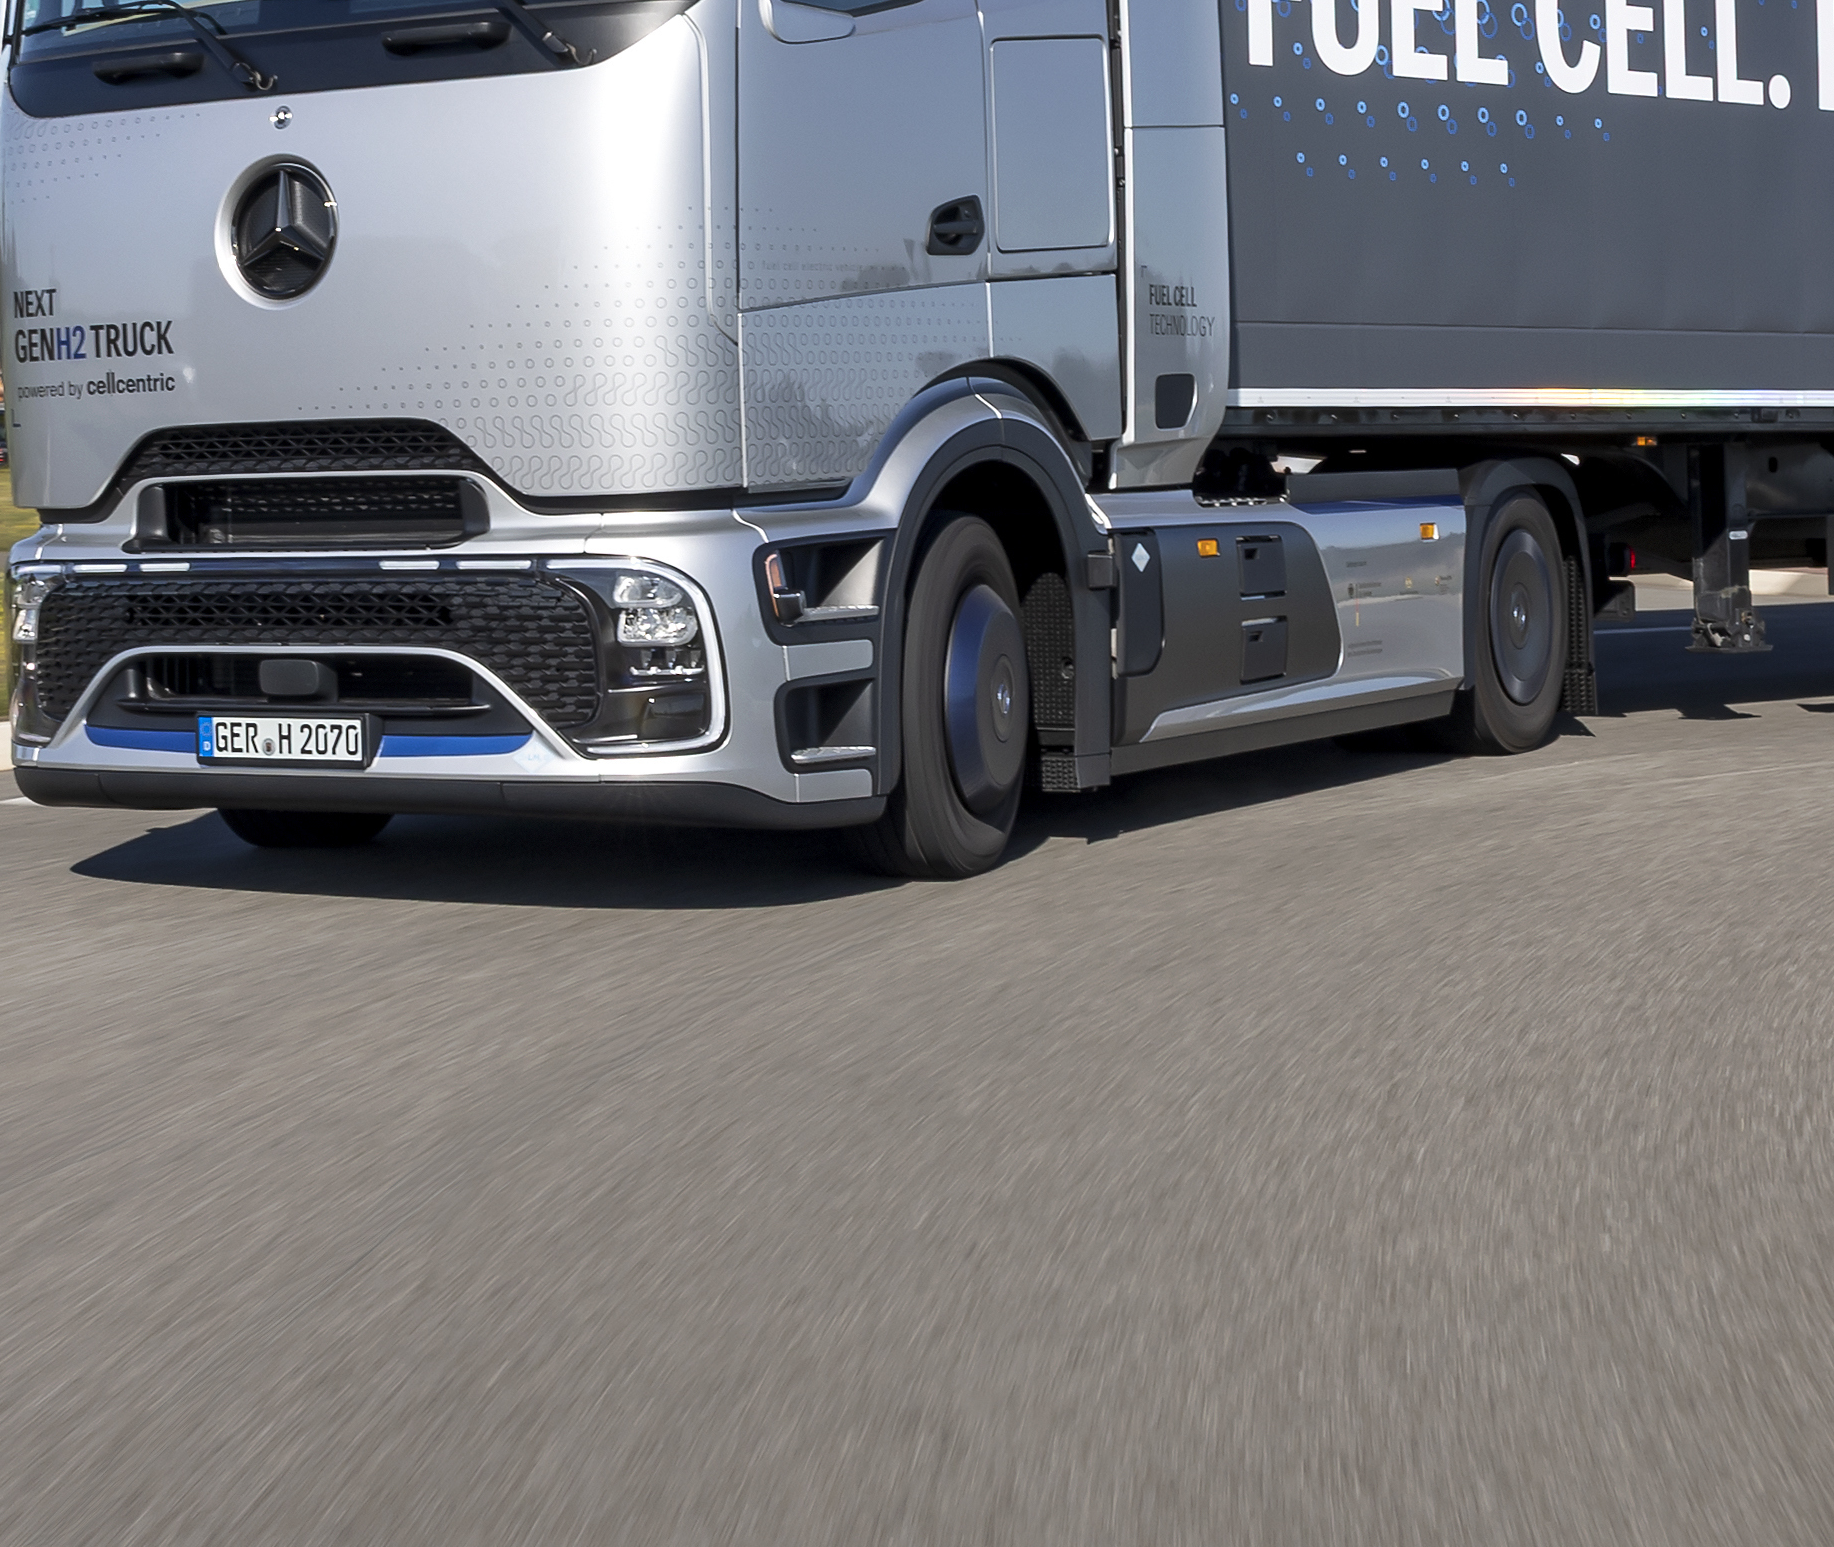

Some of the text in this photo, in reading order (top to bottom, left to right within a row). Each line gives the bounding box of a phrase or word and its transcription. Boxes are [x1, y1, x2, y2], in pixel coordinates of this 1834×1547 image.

[13, 288, 57, 319] NEXT
[1149, 283, 1197, 308] FUEL CELL
[1149, 313, 1216, 337] TECHNOLOGY
[15, 320, 175, 364] GENH2 TRUCK
[17, 370, 176, 401] powered by cellcentric
[215, 722, 360, 756] GER H 2070
